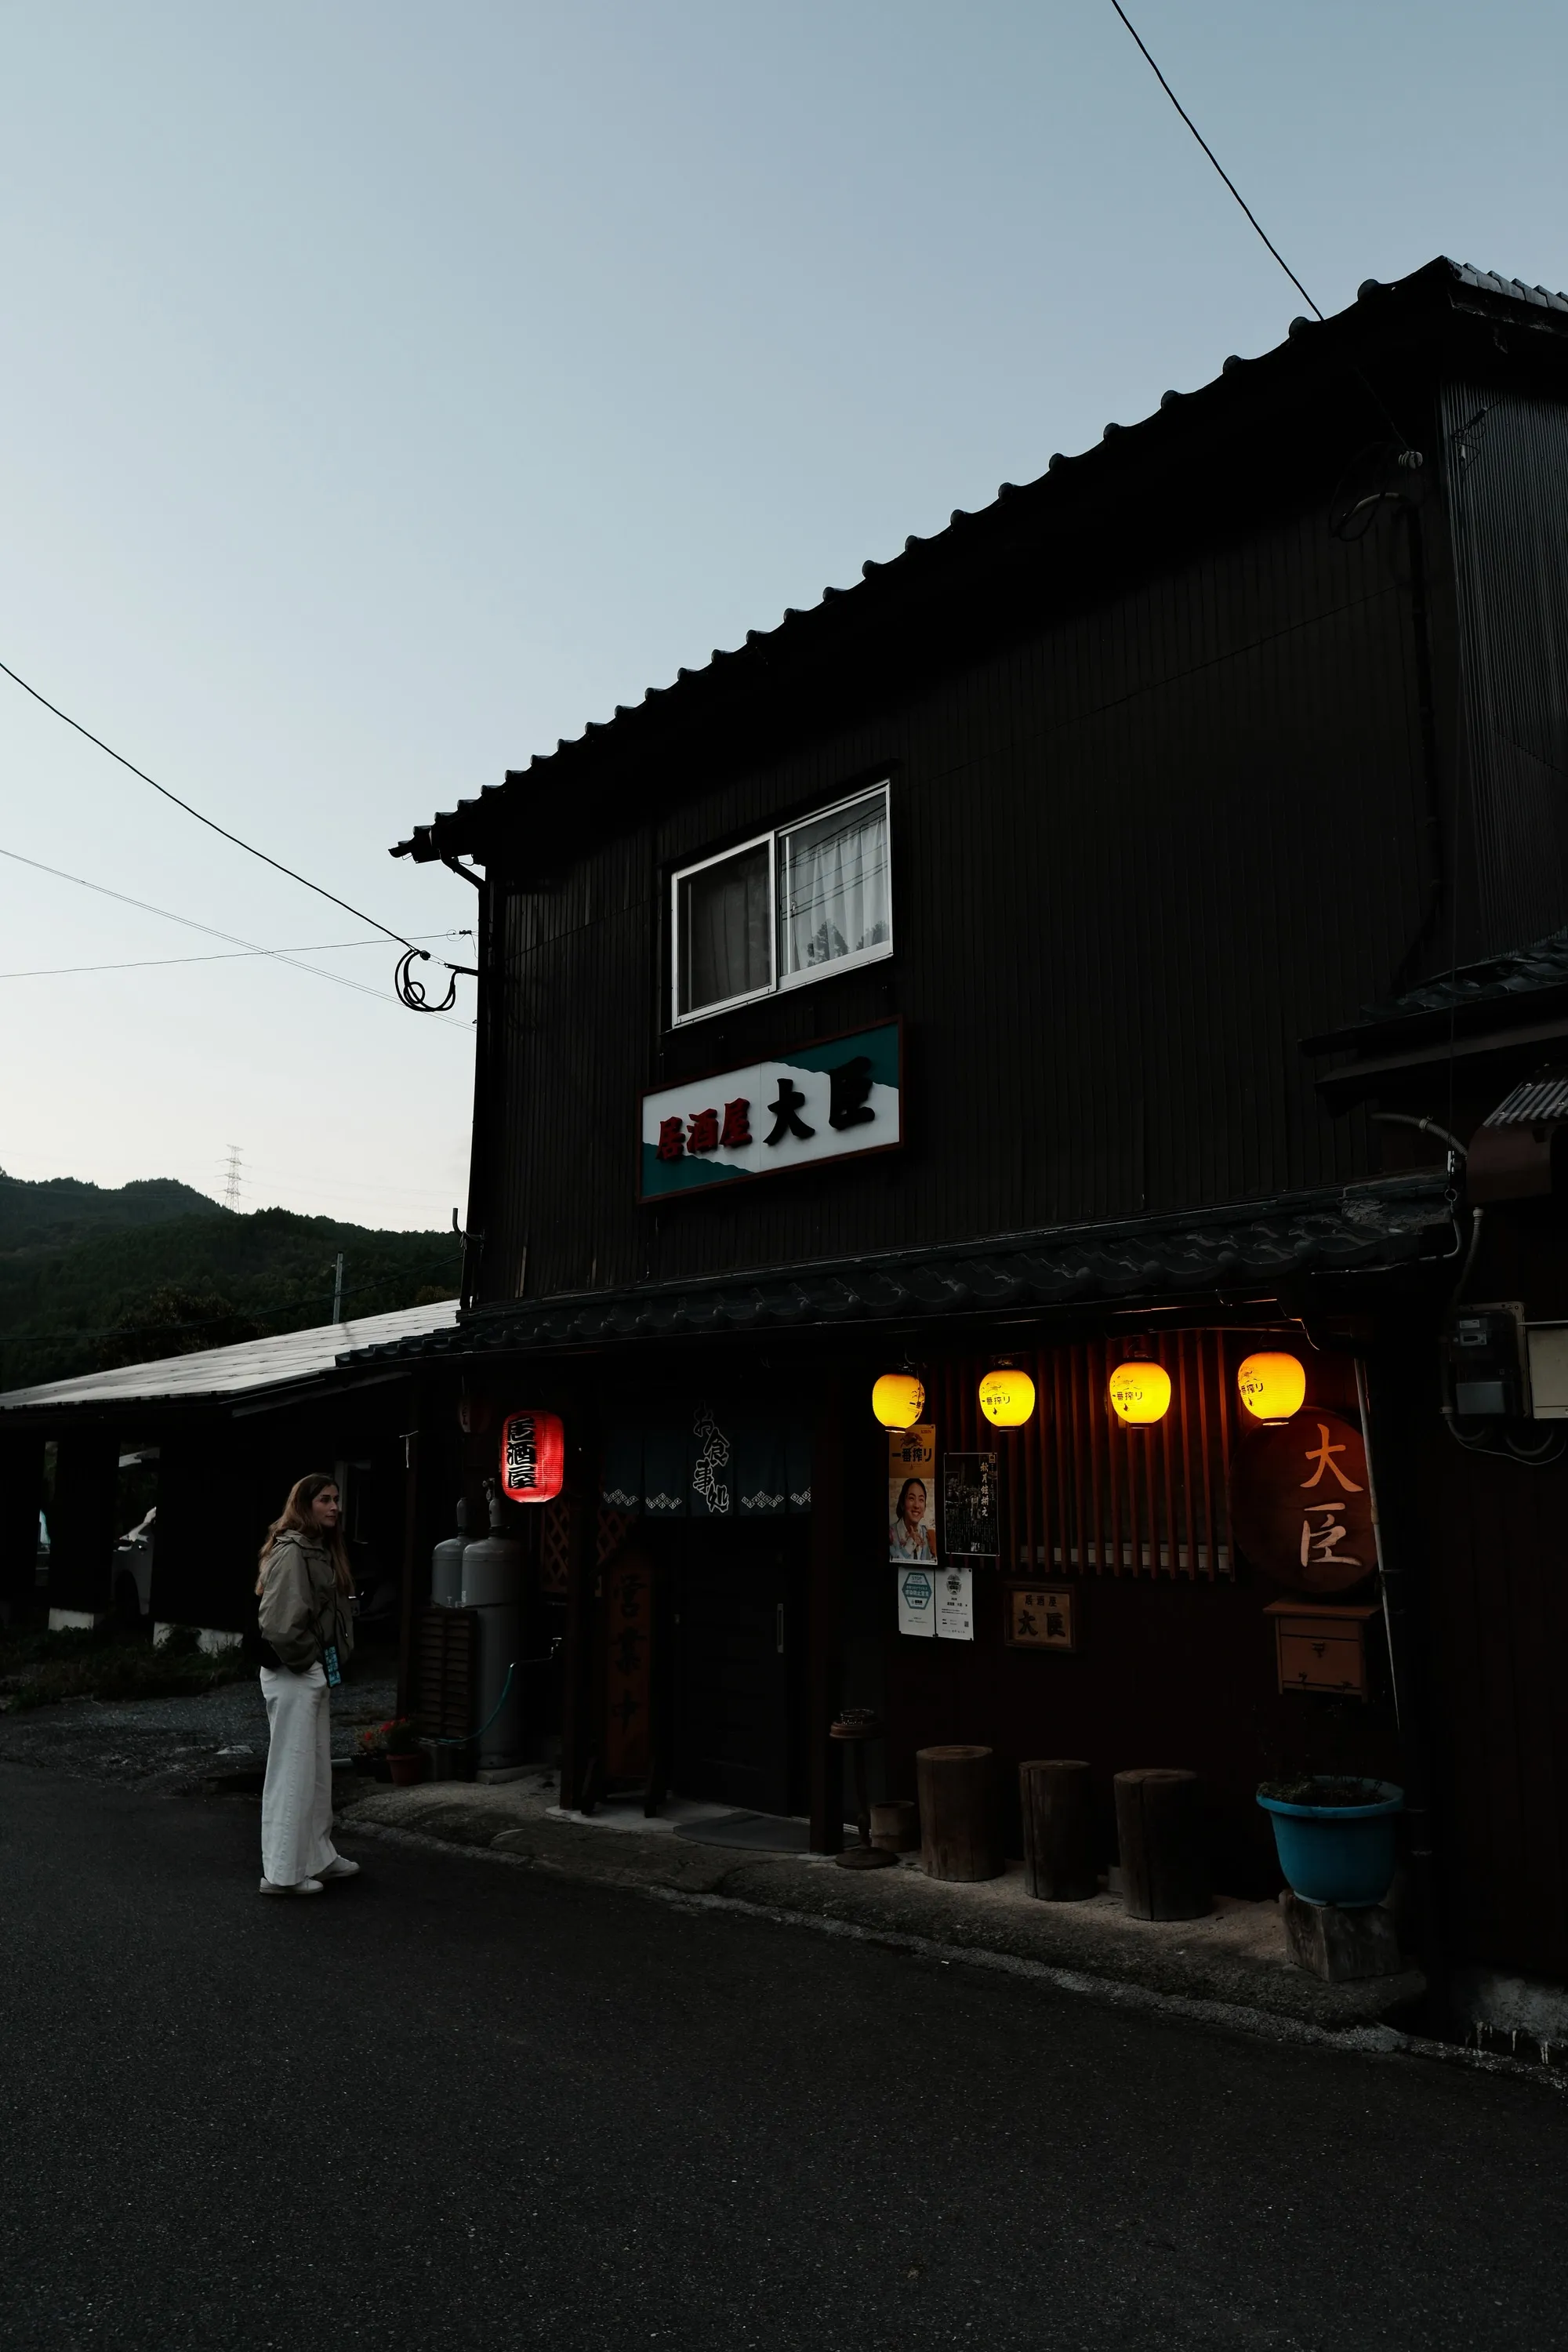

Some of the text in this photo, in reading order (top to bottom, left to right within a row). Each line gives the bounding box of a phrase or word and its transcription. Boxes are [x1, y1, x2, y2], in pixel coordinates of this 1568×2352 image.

[655, 1056, 876, 1160] 居酒屋 大臣
[692, 1399, 730, 1513] お食事処
[891, 1447, 932, 1462] 一番搾り
[1299, 1423, 1365, 1568] 大臣
[1018, 1609, 1066, 1638] 大臣
[1025, 1595, 1058, 1607] 居酒屋
[611, 1573, 648, 1735] 営業中
